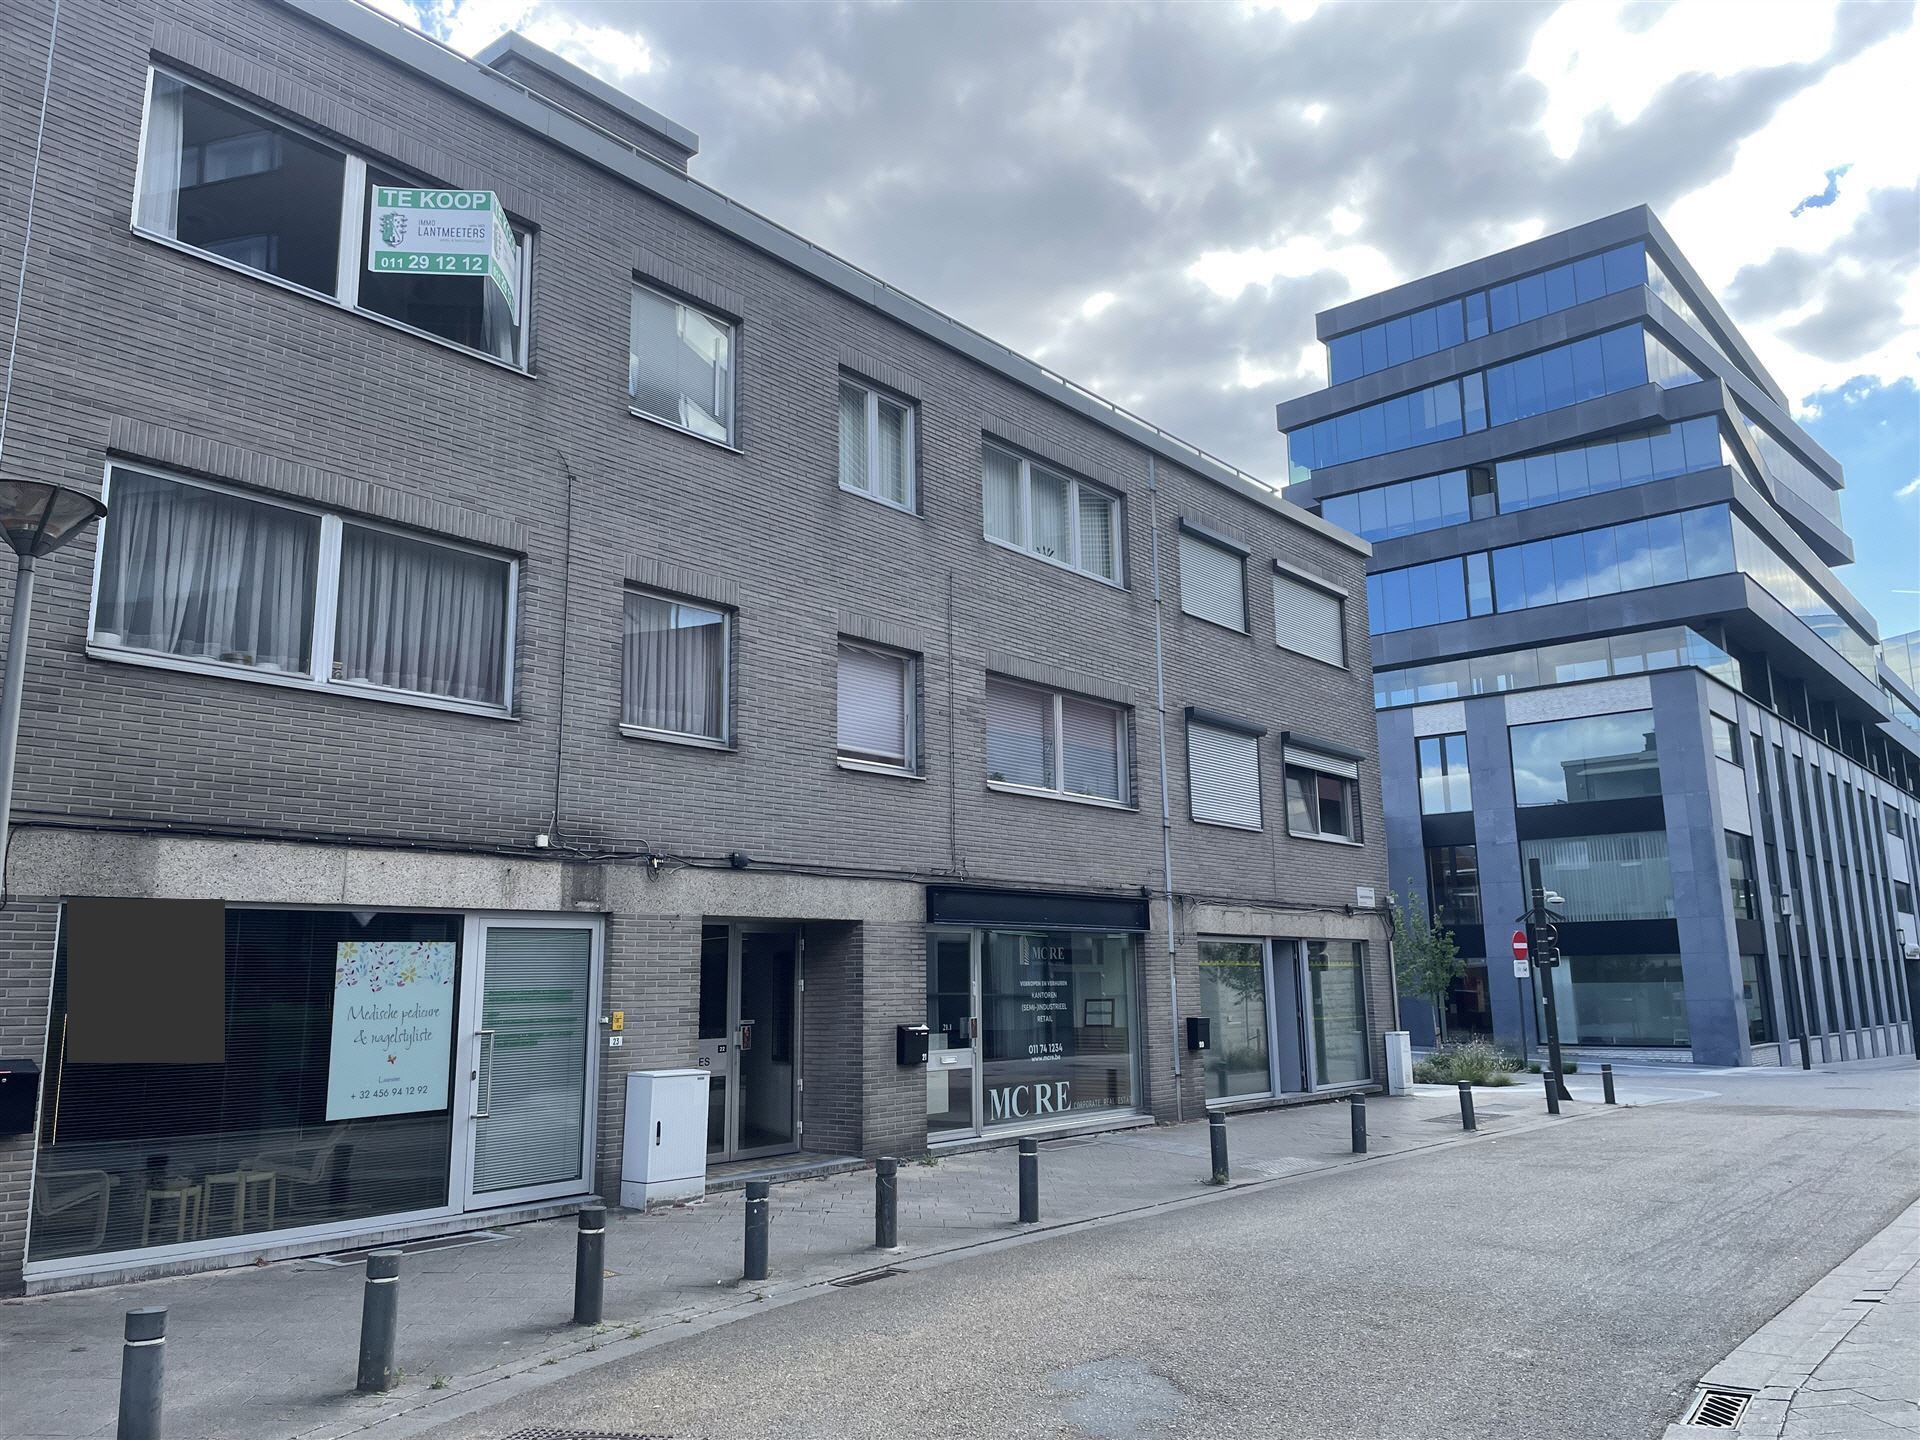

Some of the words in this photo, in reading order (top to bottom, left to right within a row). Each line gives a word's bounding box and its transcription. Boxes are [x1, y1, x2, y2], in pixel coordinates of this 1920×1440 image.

[383, 190, 412, 207] TE
[420, 191, 486, 209] KOOP
[418, 227, 485, 238] LANTMEETERS
[381, 257, 403, 268] 011
[408, 255, 429, 269] 29
[436, 256, 456, 270] 12
[463, 257, 482, 271] 12
[1032, 946, 1048, 960] MC
[1050, 946, 1065, 960] RE
[1031, 991, 1057, 999] KANTOREN
[347, 1003, 398, 1021] Medische
[401, 1002, 440, 1025] pedicure
[353, 1029, 367, 1045] &
[371, 1026, 433, 1052] nagelstyliste
[612, 1037, 620, 1046] 23
[1028, 1044, 1039, 1055] 011
[1039, 1043, 1048, 1054] 74
[1048, 1042, 1063, 1053] 1234
[698, 1057, 711, 1067] ES
[359, 1090, 370, 1099] 32
[372, 1089, 389, 1098] 456
[391, 1087, 402, 1096] 94
[406, 1086, 415, 1095] 12
[417, 1085, 428, 1094] 92
[989, 1085, 1029, 1121] MC
[1034, 1081, 1072, 1115] RE
[1073, 1099, 1100, 1109] CORPORATE
[1103, 1098, 1115, 1106] REAL
